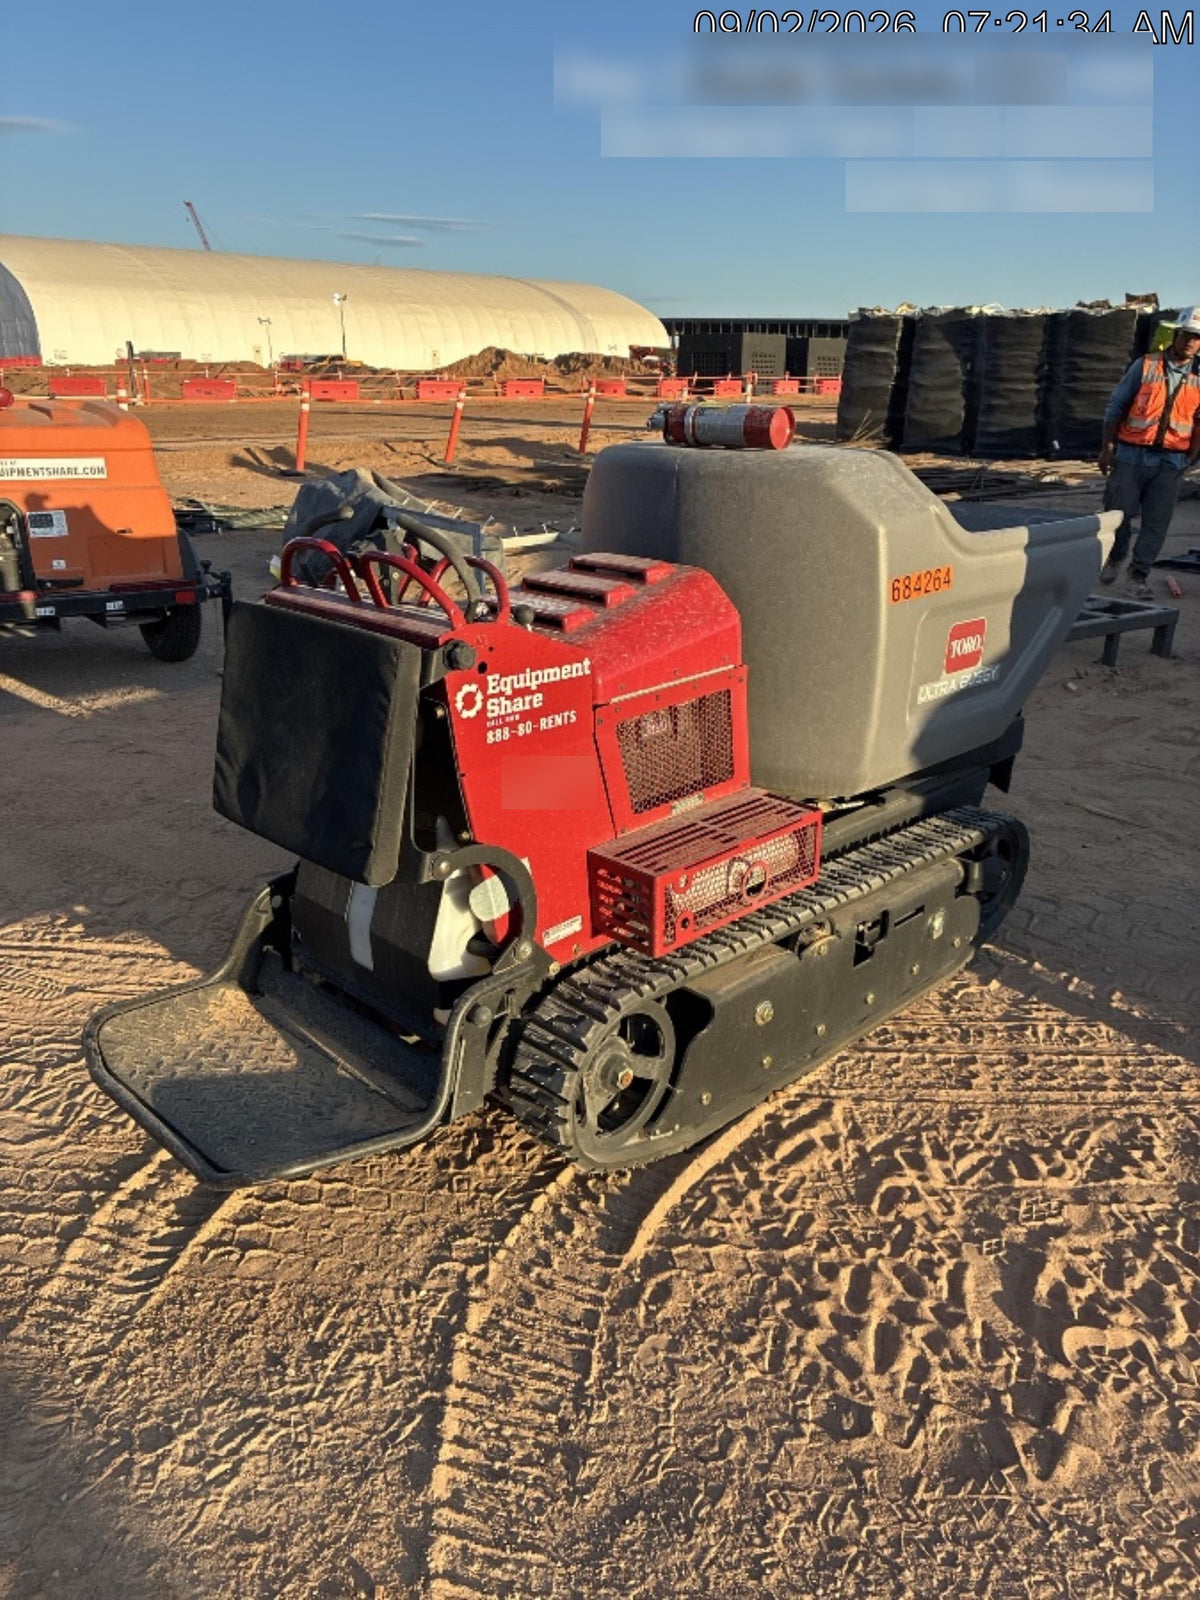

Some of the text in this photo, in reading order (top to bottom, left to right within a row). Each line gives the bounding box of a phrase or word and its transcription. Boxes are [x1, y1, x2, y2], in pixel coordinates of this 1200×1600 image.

[892, 567, 951, 602] 684264
[950, 634, 982, 658] TORO
[486, 657, 591, 695] Equipment
[486, 692, 543, 718] Share
[486, 710, 577, 744] 888-80-RENTS
